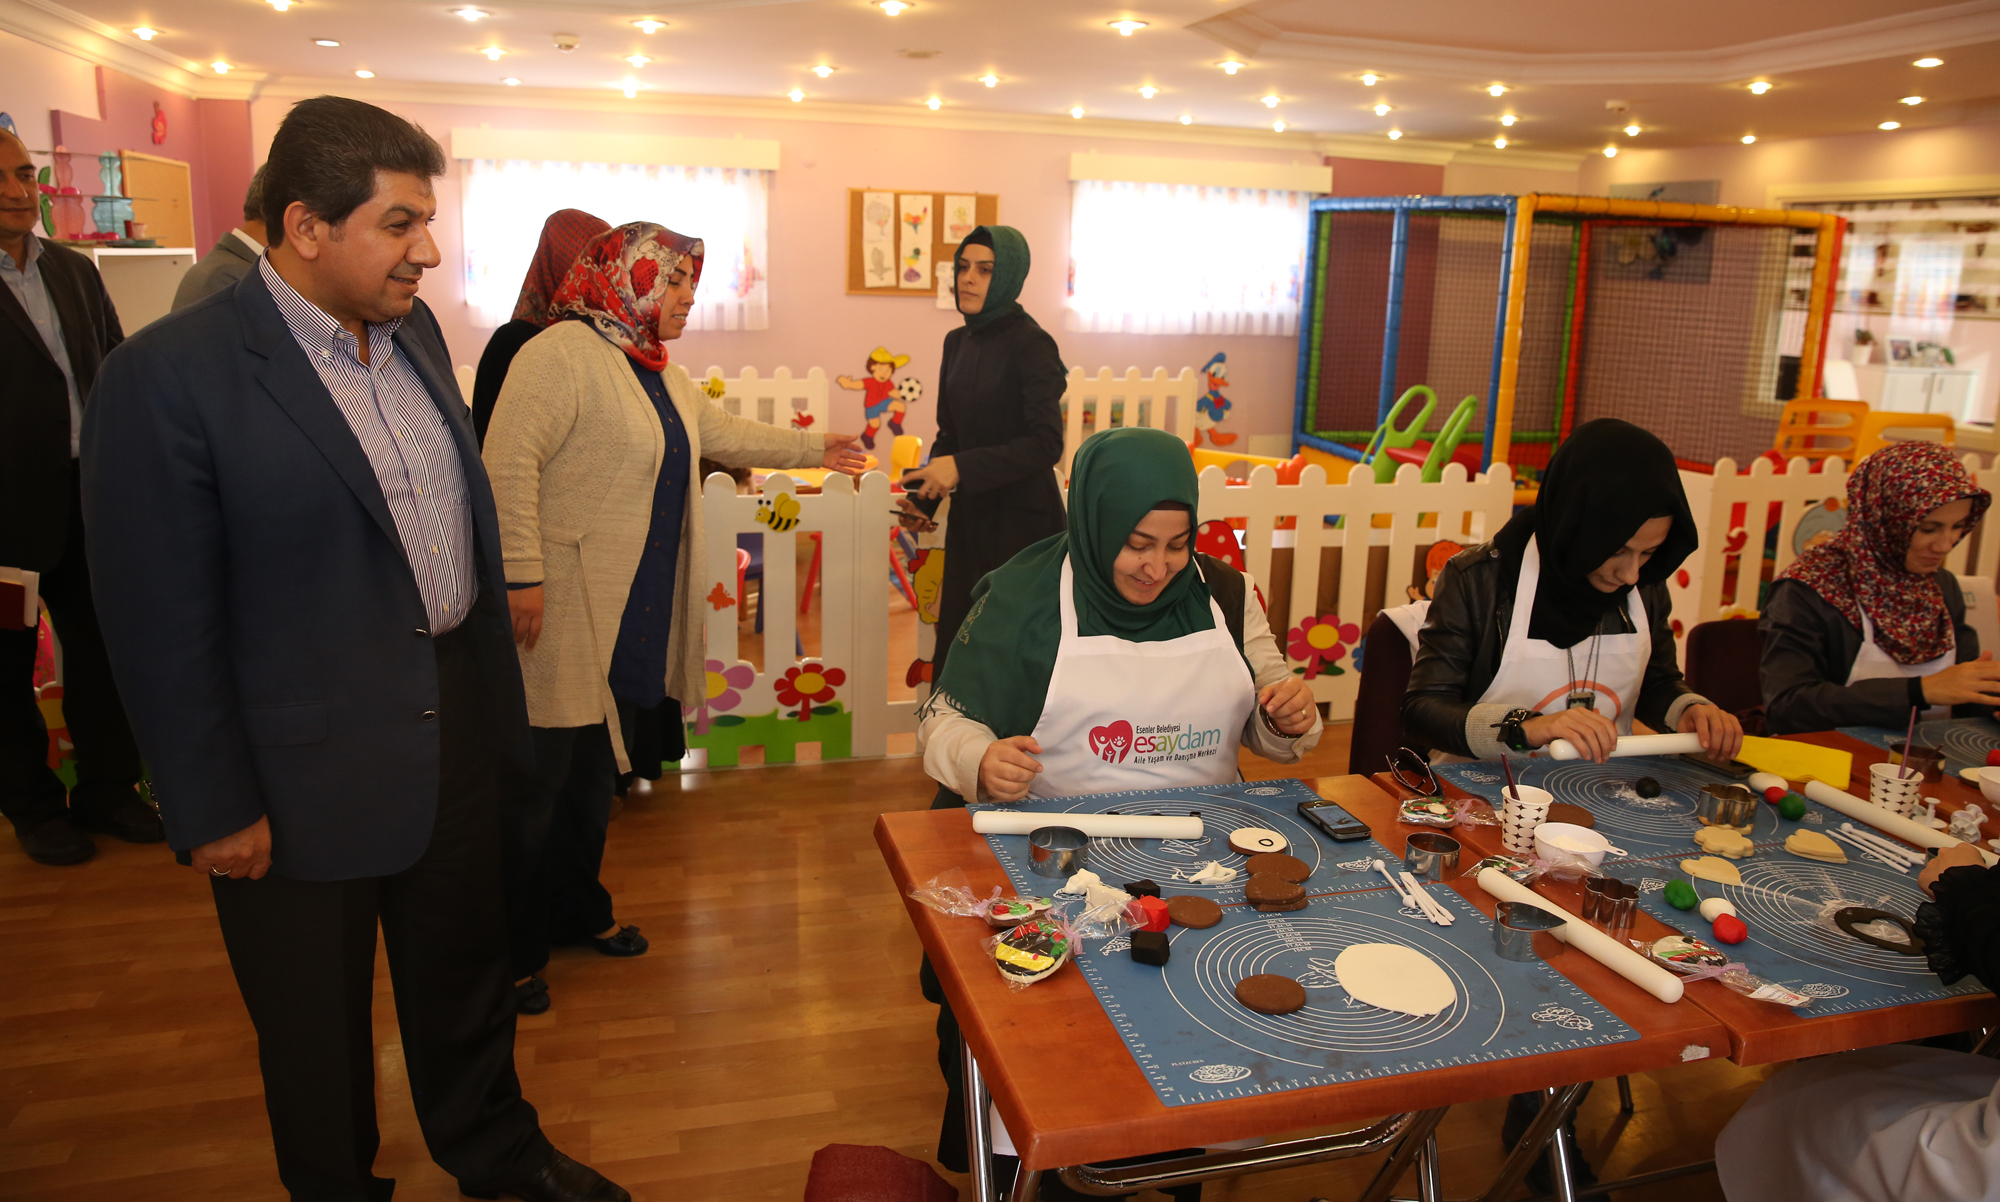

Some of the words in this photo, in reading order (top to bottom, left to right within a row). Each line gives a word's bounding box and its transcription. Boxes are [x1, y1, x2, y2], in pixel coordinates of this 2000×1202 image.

[1136, 725, 1156, 734] Esenler
[1156, 723, 1181, 734] Belediyesi
[1134, 724, 1221, 755] esaydam
[1133, 756, 1146, 764] Aile
[1147, 755, 1165, 765] Yaşam
[1197, 747, 1218, 758] Merkezi
